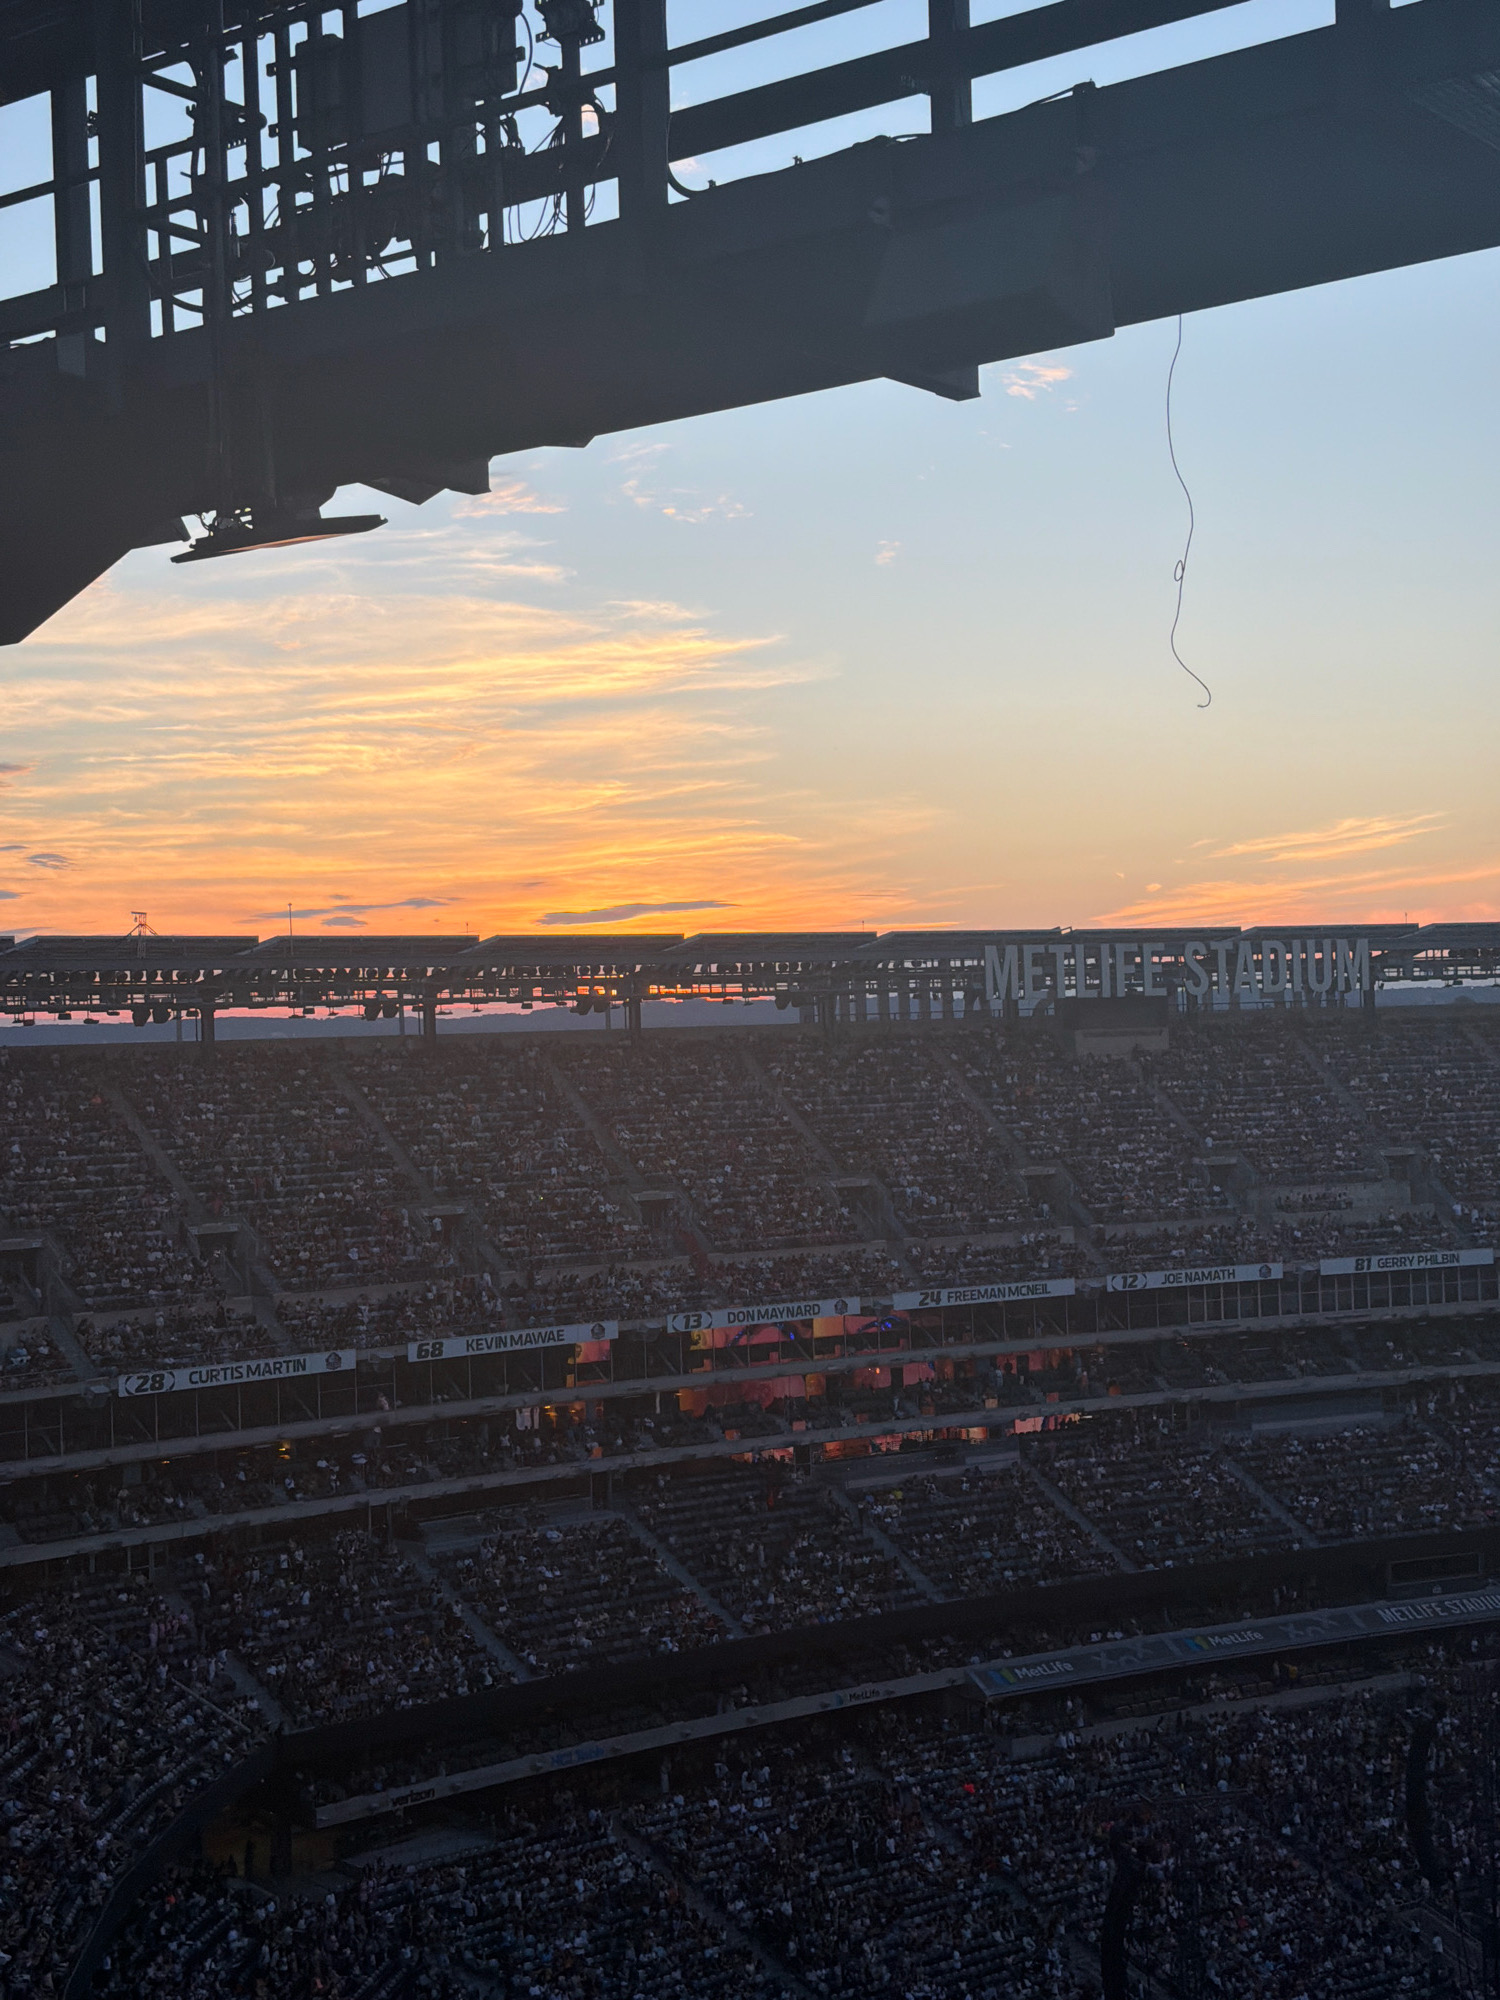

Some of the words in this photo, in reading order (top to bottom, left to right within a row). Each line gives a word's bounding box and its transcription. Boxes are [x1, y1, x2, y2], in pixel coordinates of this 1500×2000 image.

[984, 942, 1168, 1000] METLIFE
[1184, 938, 1371, 997] STADIUM
[1355, 1257, 1371, 1271] 81
[1377, 1255, 1415, 1268] GERRY
[1417, 1253, 1460, 1266] PHILBIN
[1121, 1274, 1138, 1289] 12
[1161, 1271, 1183, 1285] JOE
[1184, 1268, 1236, 1283] NAMATH
[918, 1290, 942, 1307] 24
[947, 1287, 1006, 1303] FREEMAN
[1007, 1283, 1051, 1297] MCNEIL
[682, 1313, 702, 1329] 13
[727, 1309, 755, 1324] DON
[756, 1303, 821, 1321] MAYNARD
[416, 1341, 444, 1359] 68
[465, 1335, 509, 1352] KEVIN
[509, 1329, 565, 1348] MAWAE
[134, 1372, 166, 1393] 28
[188, 1366, 243, 1385] CURTIS
[246, 1358, 307, 1379] MARTIN
[1376, 1602, 1449, 1623] METLIFE
[1444, 1593, 1500, 1614] STADIU
[1207, 1630, 1264, 1648] MetLife
[1013, 1660, 1075, 1680] MetLife
